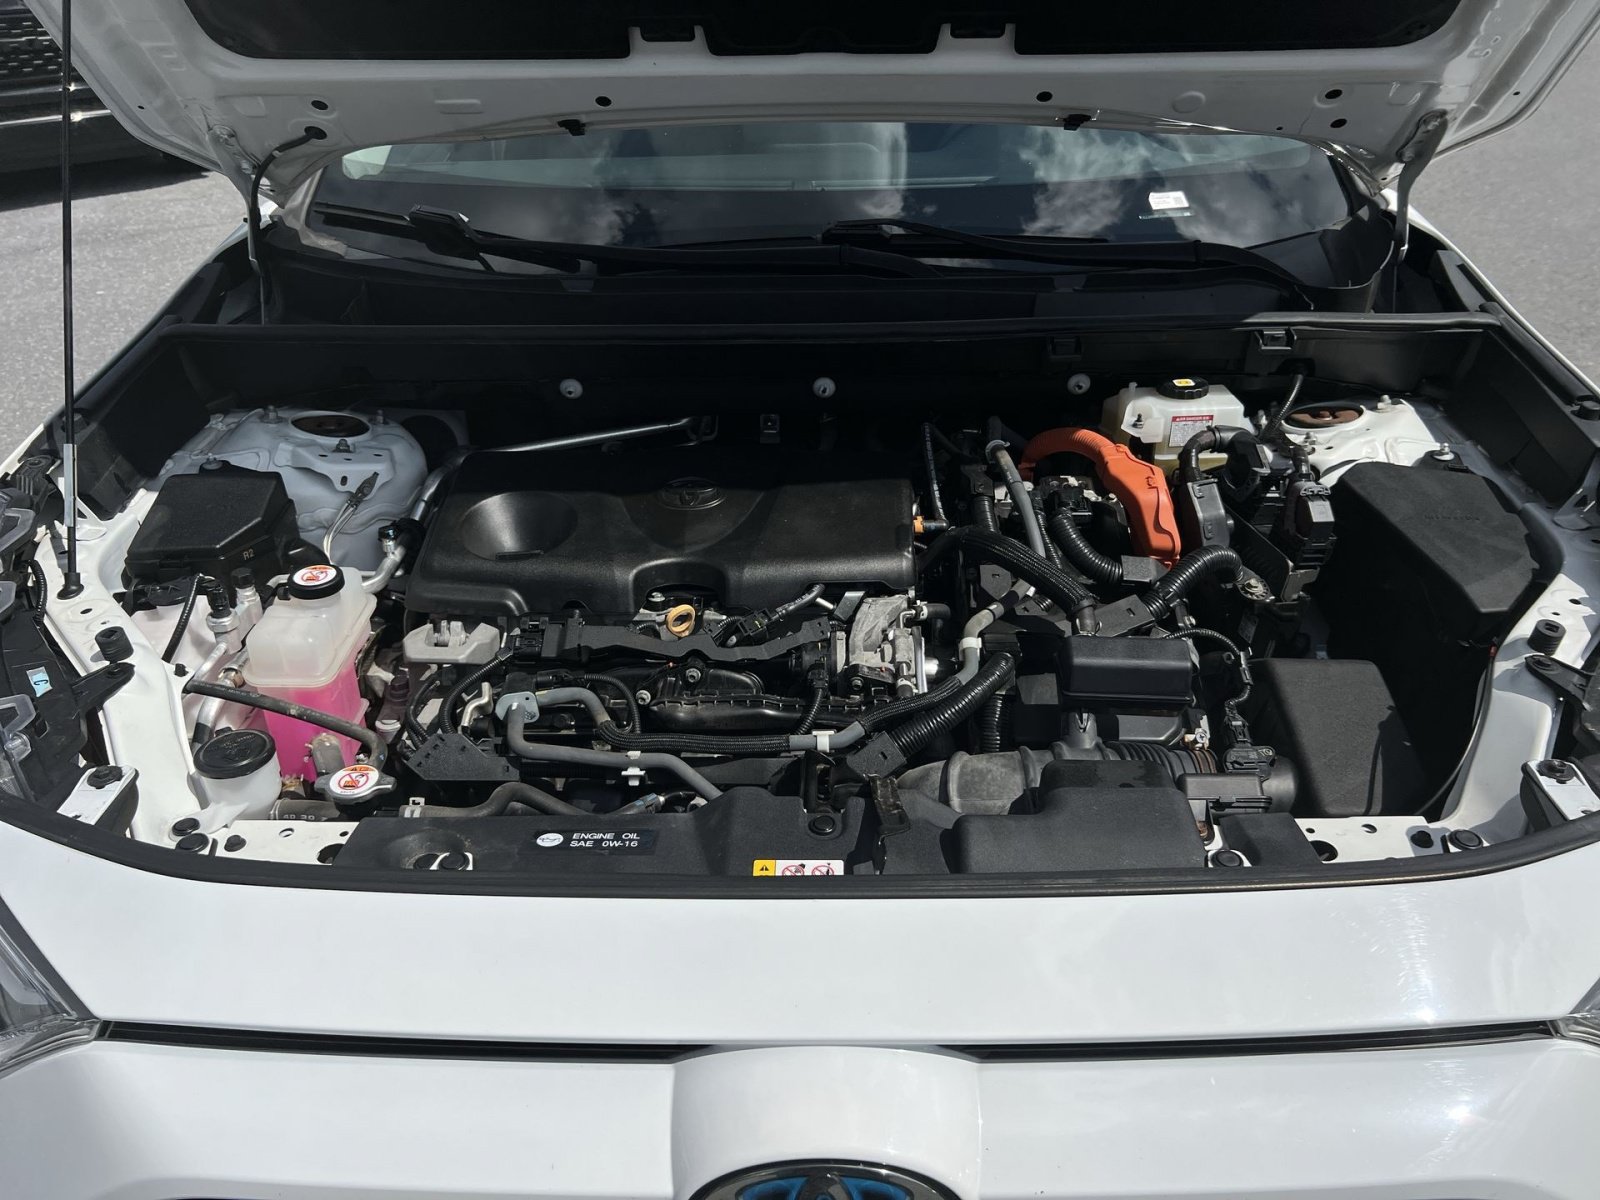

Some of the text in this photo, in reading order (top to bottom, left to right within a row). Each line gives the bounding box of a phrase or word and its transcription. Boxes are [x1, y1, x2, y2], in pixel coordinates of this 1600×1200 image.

[243, 548, 255, 560] R2
[572, 832, 641, 840] ENGINE OIL
